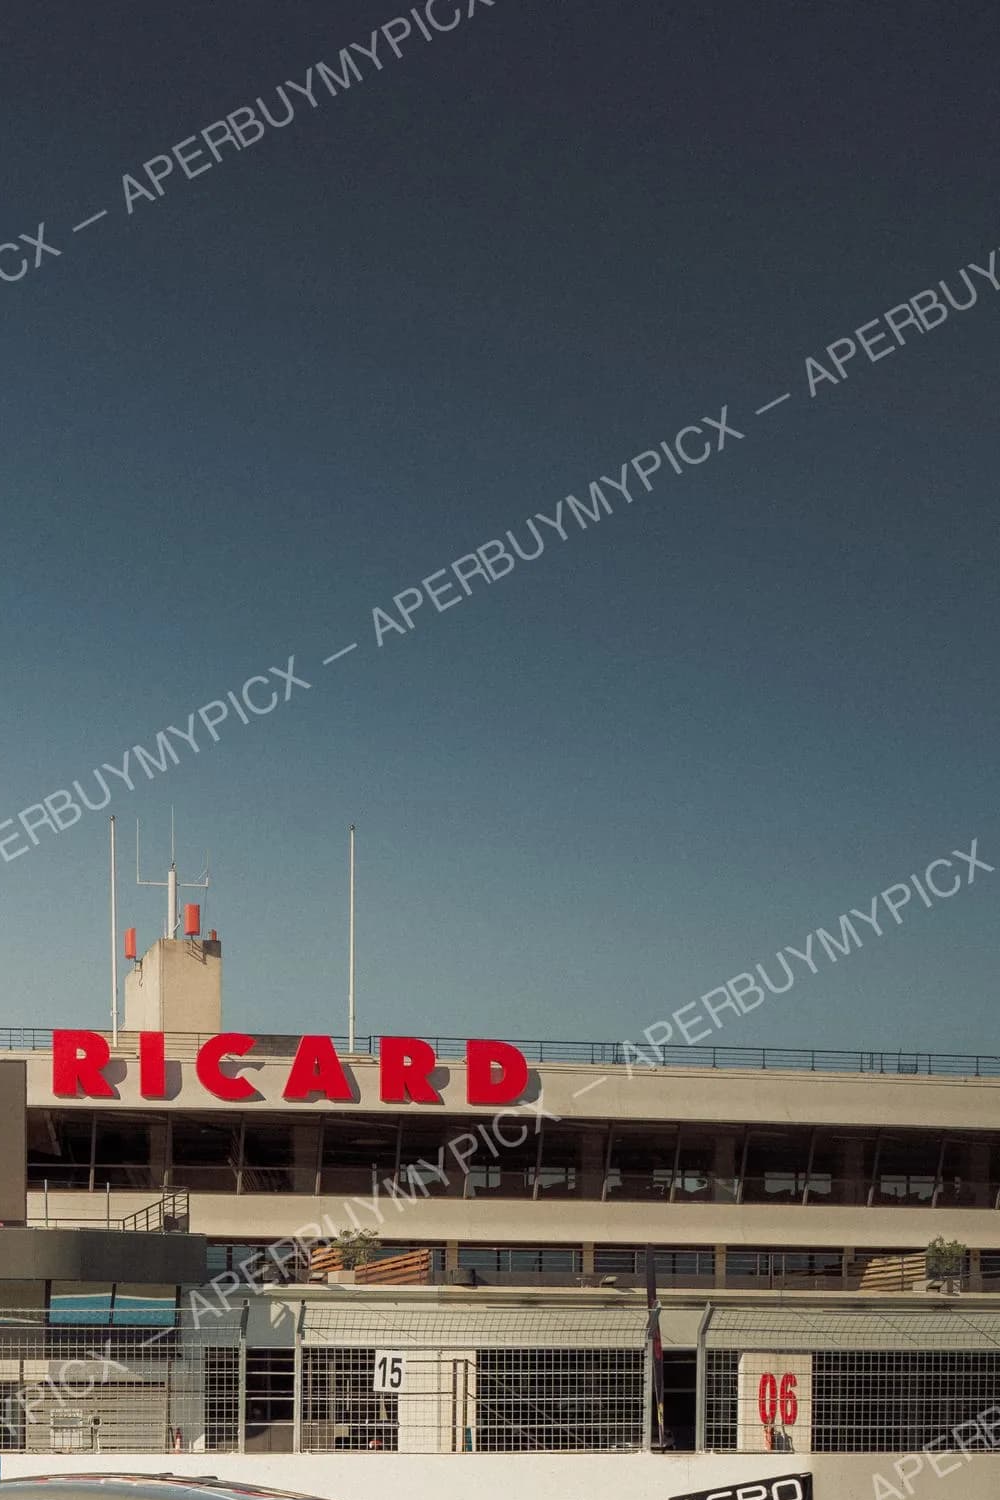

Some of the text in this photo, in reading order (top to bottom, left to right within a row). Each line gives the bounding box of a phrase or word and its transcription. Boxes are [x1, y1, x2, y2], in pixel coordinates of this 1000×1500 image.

[52, 1028, 529, 1105] RICARD
[378, 1356, 403, 1388] 15
[758, 1371, 798, 1426] 06
